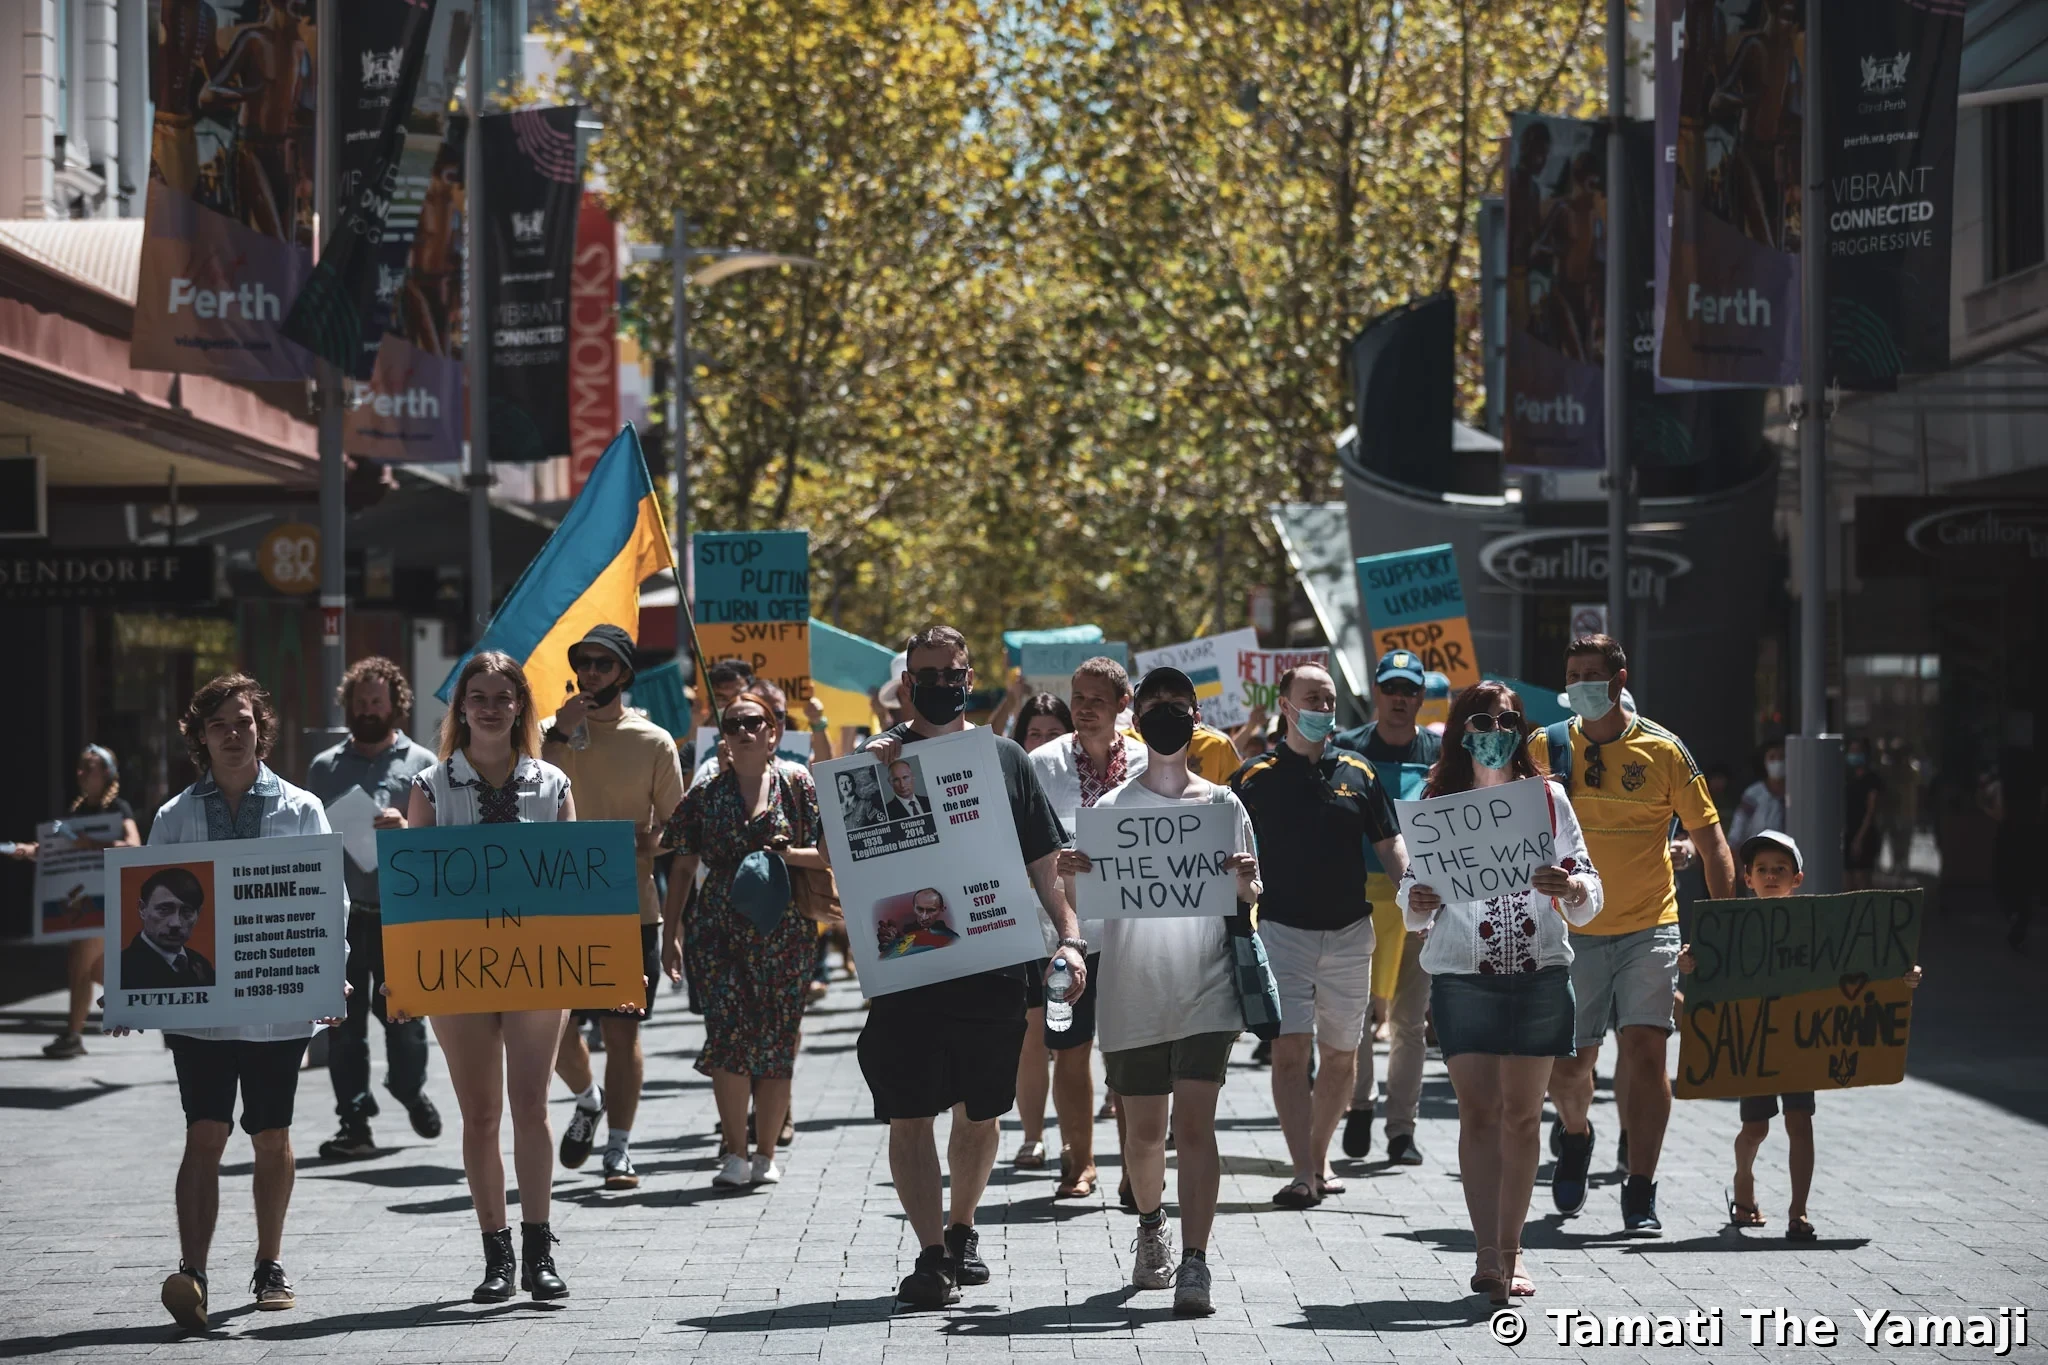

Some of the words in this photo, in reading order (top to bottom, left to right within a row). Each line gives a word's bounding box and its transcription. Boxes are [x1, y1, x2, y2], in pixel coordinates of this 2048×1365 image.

[1884, 97, 1907, 111] Perth
[1843, 129, 1919, 149] perth.wa.gov.au
[1831, 166, 1935, 203] VIBRANT
[1830, 201, 1934, 232] CONNECTED
[1831, 229, 1933, 257] PROGRESSIVE
[168, 278, 281, 322] Perth
[1687, 283, 1772, 327] Perth
[569, 243, 612, 484] DYMOCKS
[352, 381, 441, 418] Perth
[1514, 392, 1587, 425] Perth
[1937, 511, 2031, 545] Carillon
[272, 536, 316, 563] en
[702, 540, 764, 566] STOP
[1507, 541, 1609, 580] Carillo
[273, 562, 315, 583] ex
[741, 568, 809, 594] PUTIN
[1368, 552, 1452, 589] SUPPORT
[700, 600, 758, 622] TURN
[768, 599, 809, 620] OFF
[1382, 581, 1461, 616] UKRAINE
[732, 623, 809, 643] SWIFT
[1382, 623, 1444, 652] STOP
[1178, 640, 1216, 664] WAR
[941, 771, 962, 784] vote
[963, 769, 973, 780] to
[946, 784, 969, 798] STOP
[943, 800, 958, 812] the
[960, 796, 980, 808] new
[900, 819, 925, 830] Crimea
[949, 809, 980, 825] HITLER
[1411, 799, 1512, 844] STOP
[848, 825, 891, 841] Sudetenland
[863, 836, 883, 848] 1938
[905, 826, 925, 838] 2014
[1117, 814, 1201, 848] STOP
[1414, 846, 1480, 875] THE
[1490, 832, 1553, 863] WAR
[242, 865, 251, 876] is
[253, 865, 269, 876] not
[271, 864, 290, 877] just
[293, 862, 322, 873] about
[391, 844, 508, 897] STOP
[520, 847, 611, 890] WAR
[1091, 856, 1160, 881] THE
[1167, 851, 1228, 879] WAR
[233, 881, 297, 900] UKRAINE
[968, 882, 989, 895] vote
[989, 879, 1000, 890] to
[1451, 863, 1531, 900] NOW
[973, 893, 996, 907] STOP
[1120, 881, 1206, 910] NOW
[234, 915, 254, 926] Like
[256, 914, 263, 924] it
[265, 914, 285, 924] was
[287, 911, 316, 922] never
[485, 907, 522, 928] IN
[969, 906, 1007, 922] Russian
[233, 932, 253, 944] just
[255, 930, 284, 942] about
[286, 926, 328, 940] Austria,
[966, 917, 1017, 936] Imperialism
[1695, 905, 1791, 983] STOP
[1776, 944, 1809, 970] THE
[1810, 895, 1915, 972] WAR
[234, 949, 267, 961] Czech
[269, 946, 315, 959] Sudeten
[234, 968, 253, 980] and
[255, 965, 293, 978] Poland
[296, 963, 321, 975] back
[417, 945, 616, 991] UKRAINE
[128, 991, 209, 1006] PUTLER
[234, 987, 245, 998] in
[246, 983, 304, 997] 1938-1939
[1686, 996, 1781, 1086] SAVE
[1794, 996, 1910, 1049] UKRAINE
